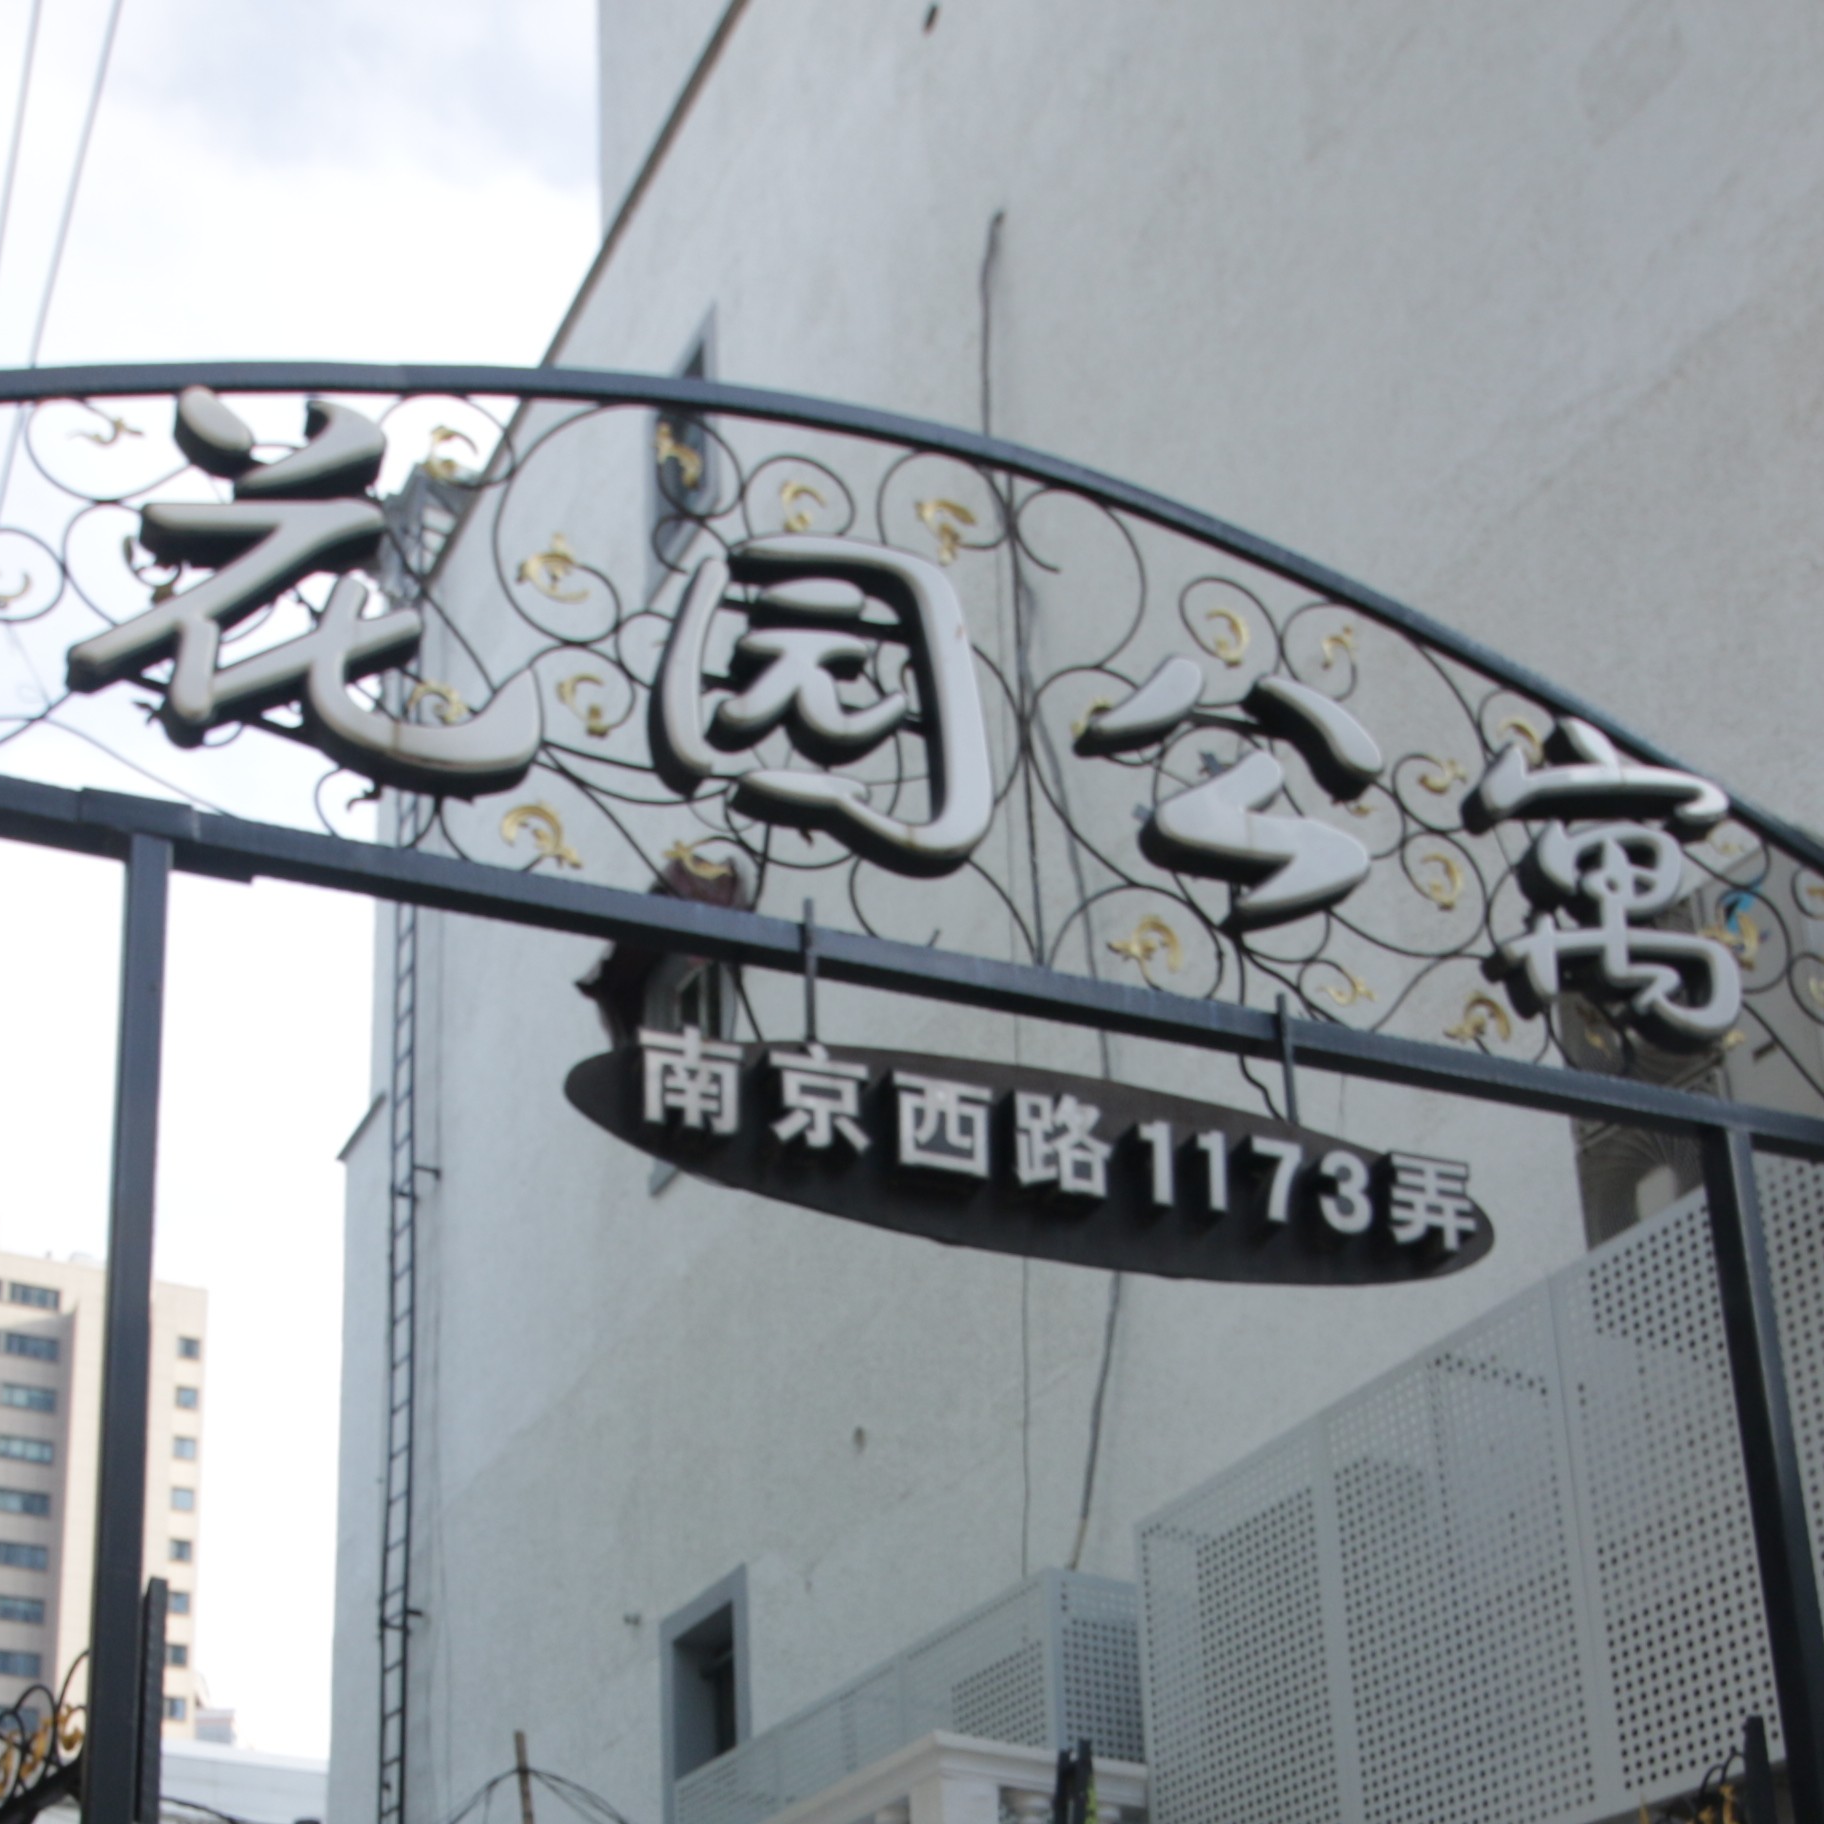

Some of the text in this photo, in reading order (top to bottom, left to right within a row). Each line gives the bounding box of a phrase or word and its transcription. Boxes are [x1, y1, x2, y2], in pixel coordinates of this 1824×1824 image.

[66, 386, 1744, 1052] 花园公寓
[637, 1026, 1478, 1252] 南京西路1173弄
